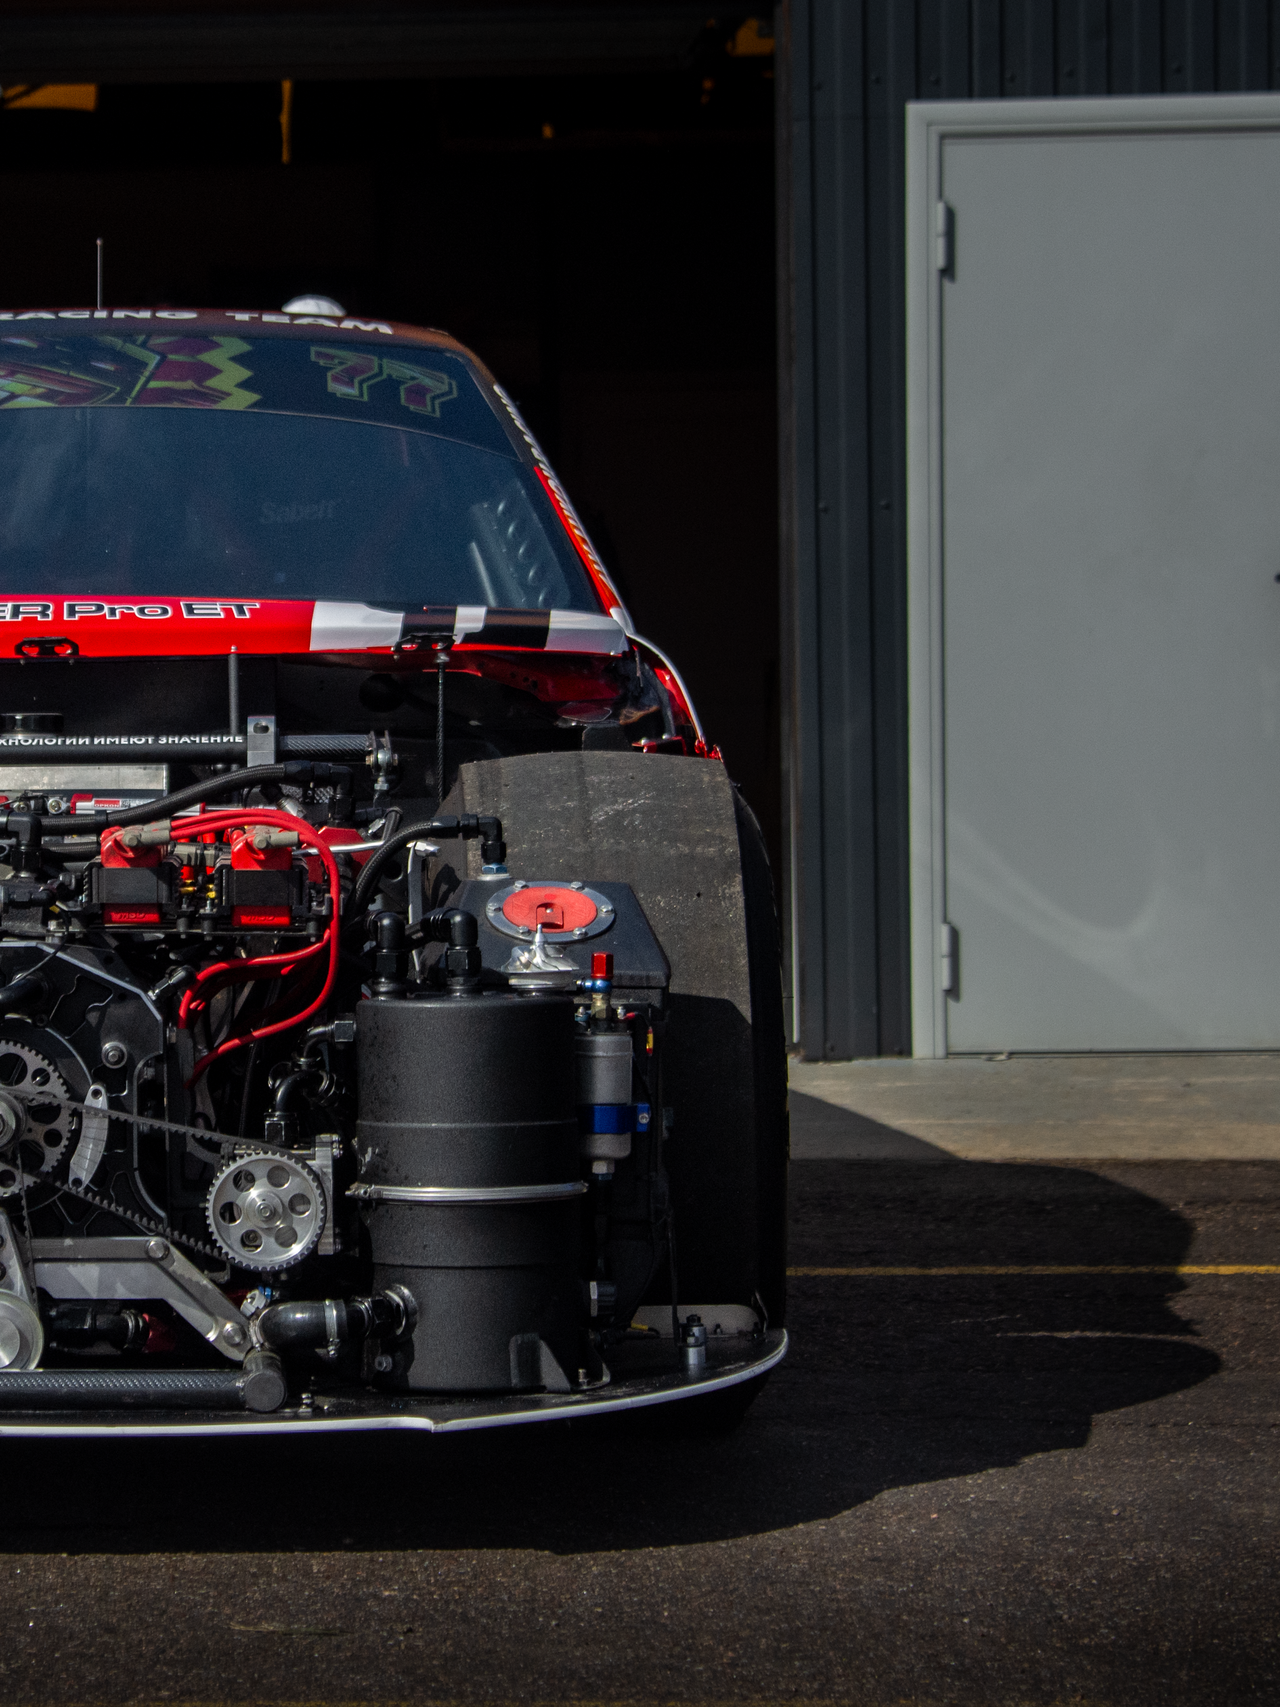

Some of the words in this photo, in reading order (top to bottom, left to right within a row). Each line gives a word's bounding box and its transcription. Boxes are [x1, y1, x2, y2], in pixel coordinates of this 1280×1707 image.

[225, 312, 394, 335] TEAM
[310, 346, 458, 418] 77
[63, 601, 173, 620] Pro
[180, 601, 260, 619] ET
[93, 735, 155, 745] ИМЕЮТ
[158, 735, 244, 744] ЗНАЧЕНИЕ
